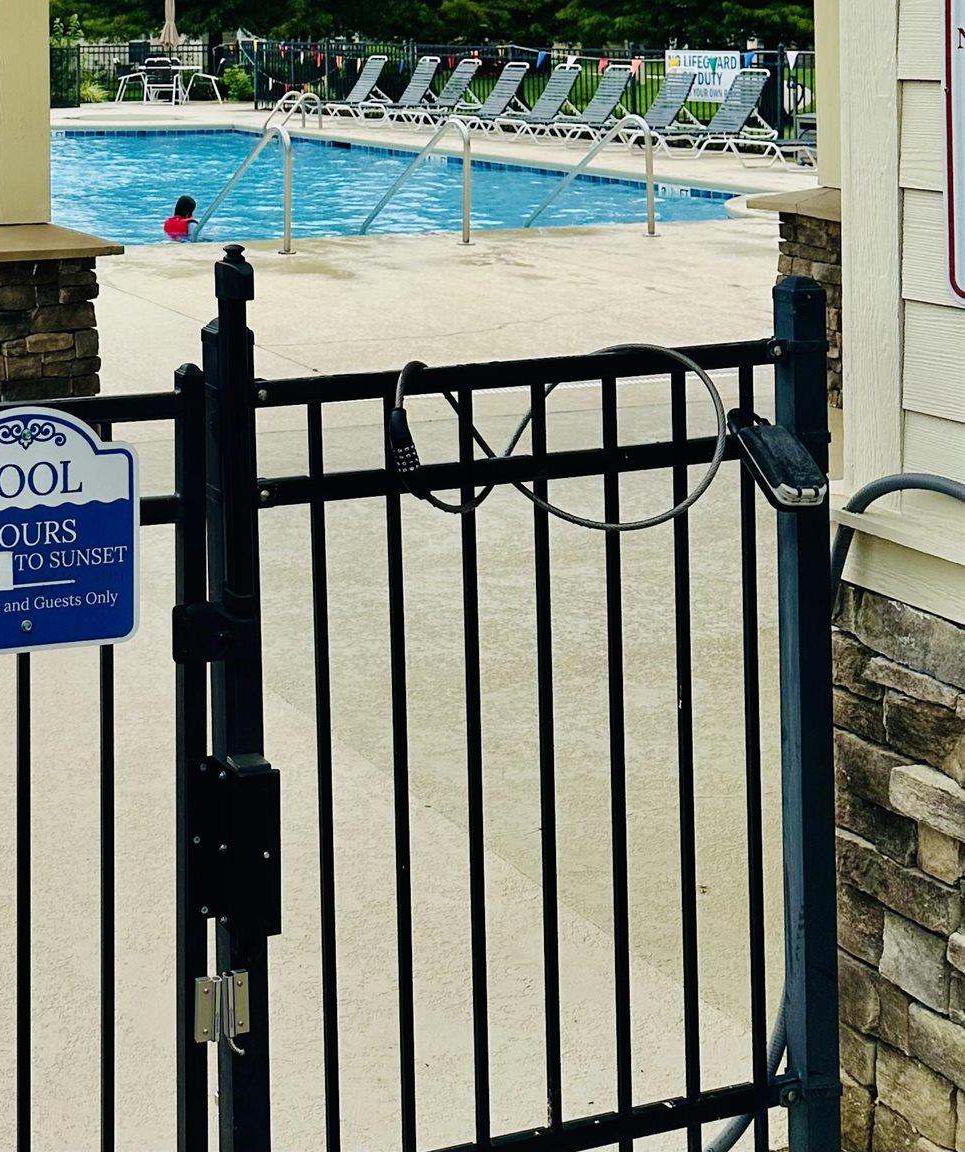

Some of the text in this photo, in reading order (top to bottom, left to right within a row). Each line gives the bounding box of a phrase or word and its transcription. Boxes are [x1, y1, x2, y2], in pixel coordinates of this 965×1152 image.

[684, 55, 737, 69] LIFEGARD
[698, 72, 722, 85] DUTY
[14, 545, 128, 572] TO SUNSET
[4, 597, 30, 613] and
[34, 594, 82, 610] Guests
[85, 589, 119, 607] Only
